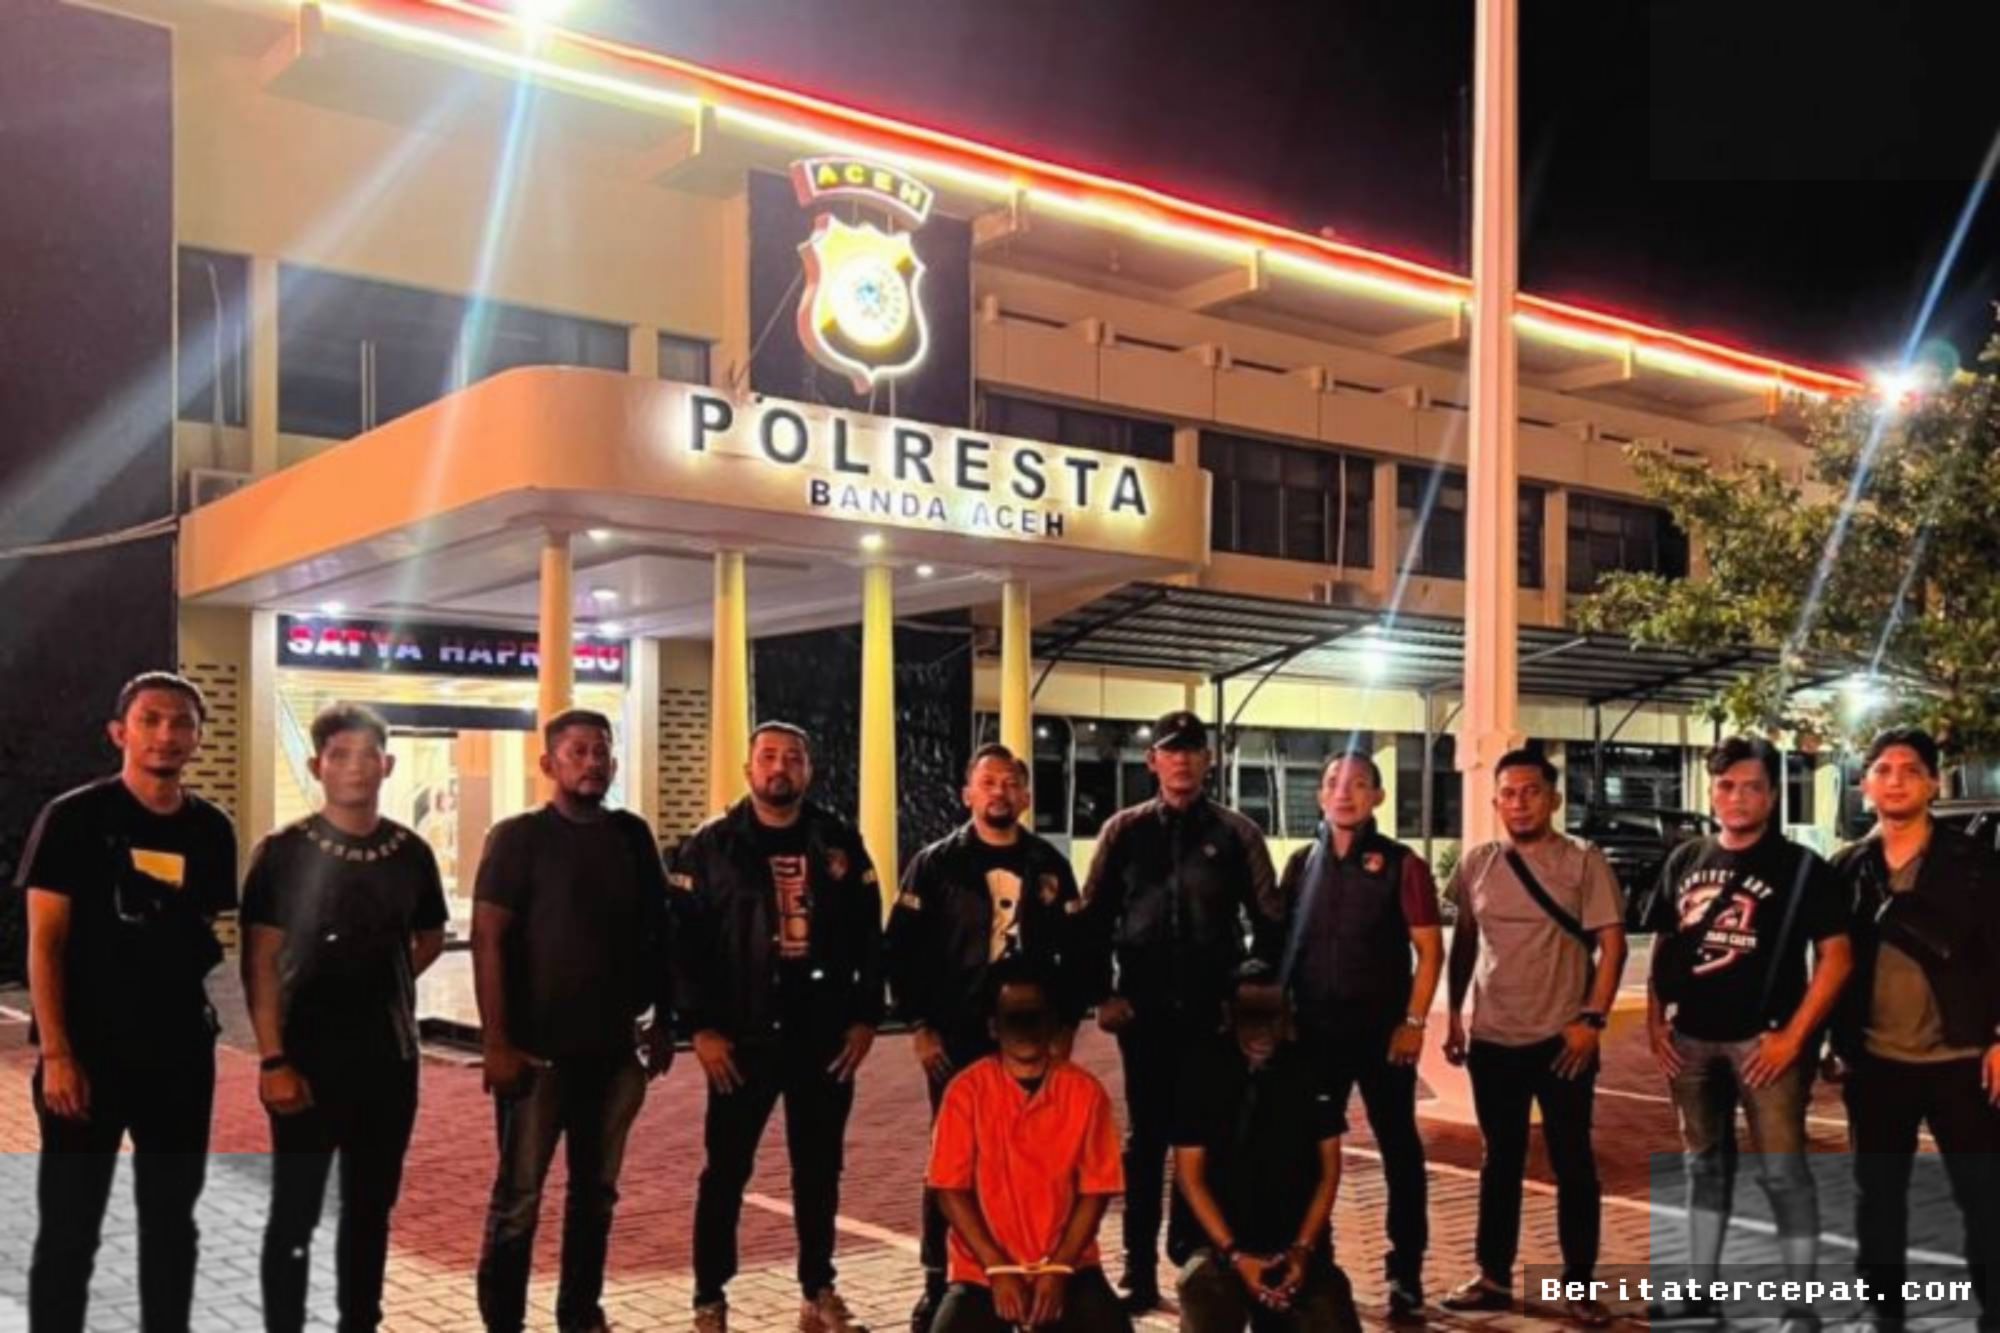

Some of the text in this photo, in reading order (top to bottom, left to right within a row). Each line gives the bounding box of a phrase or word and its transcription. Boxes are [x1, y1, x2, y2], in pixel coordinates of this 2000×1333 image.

[816, 163, 924, 205] ACEH
[690, 394, 1147, 516] POLRESTA
[811, 480, 1063, 536] BANDA ACEH
[288, 627, 623, 672] SATYA HAPRBU
